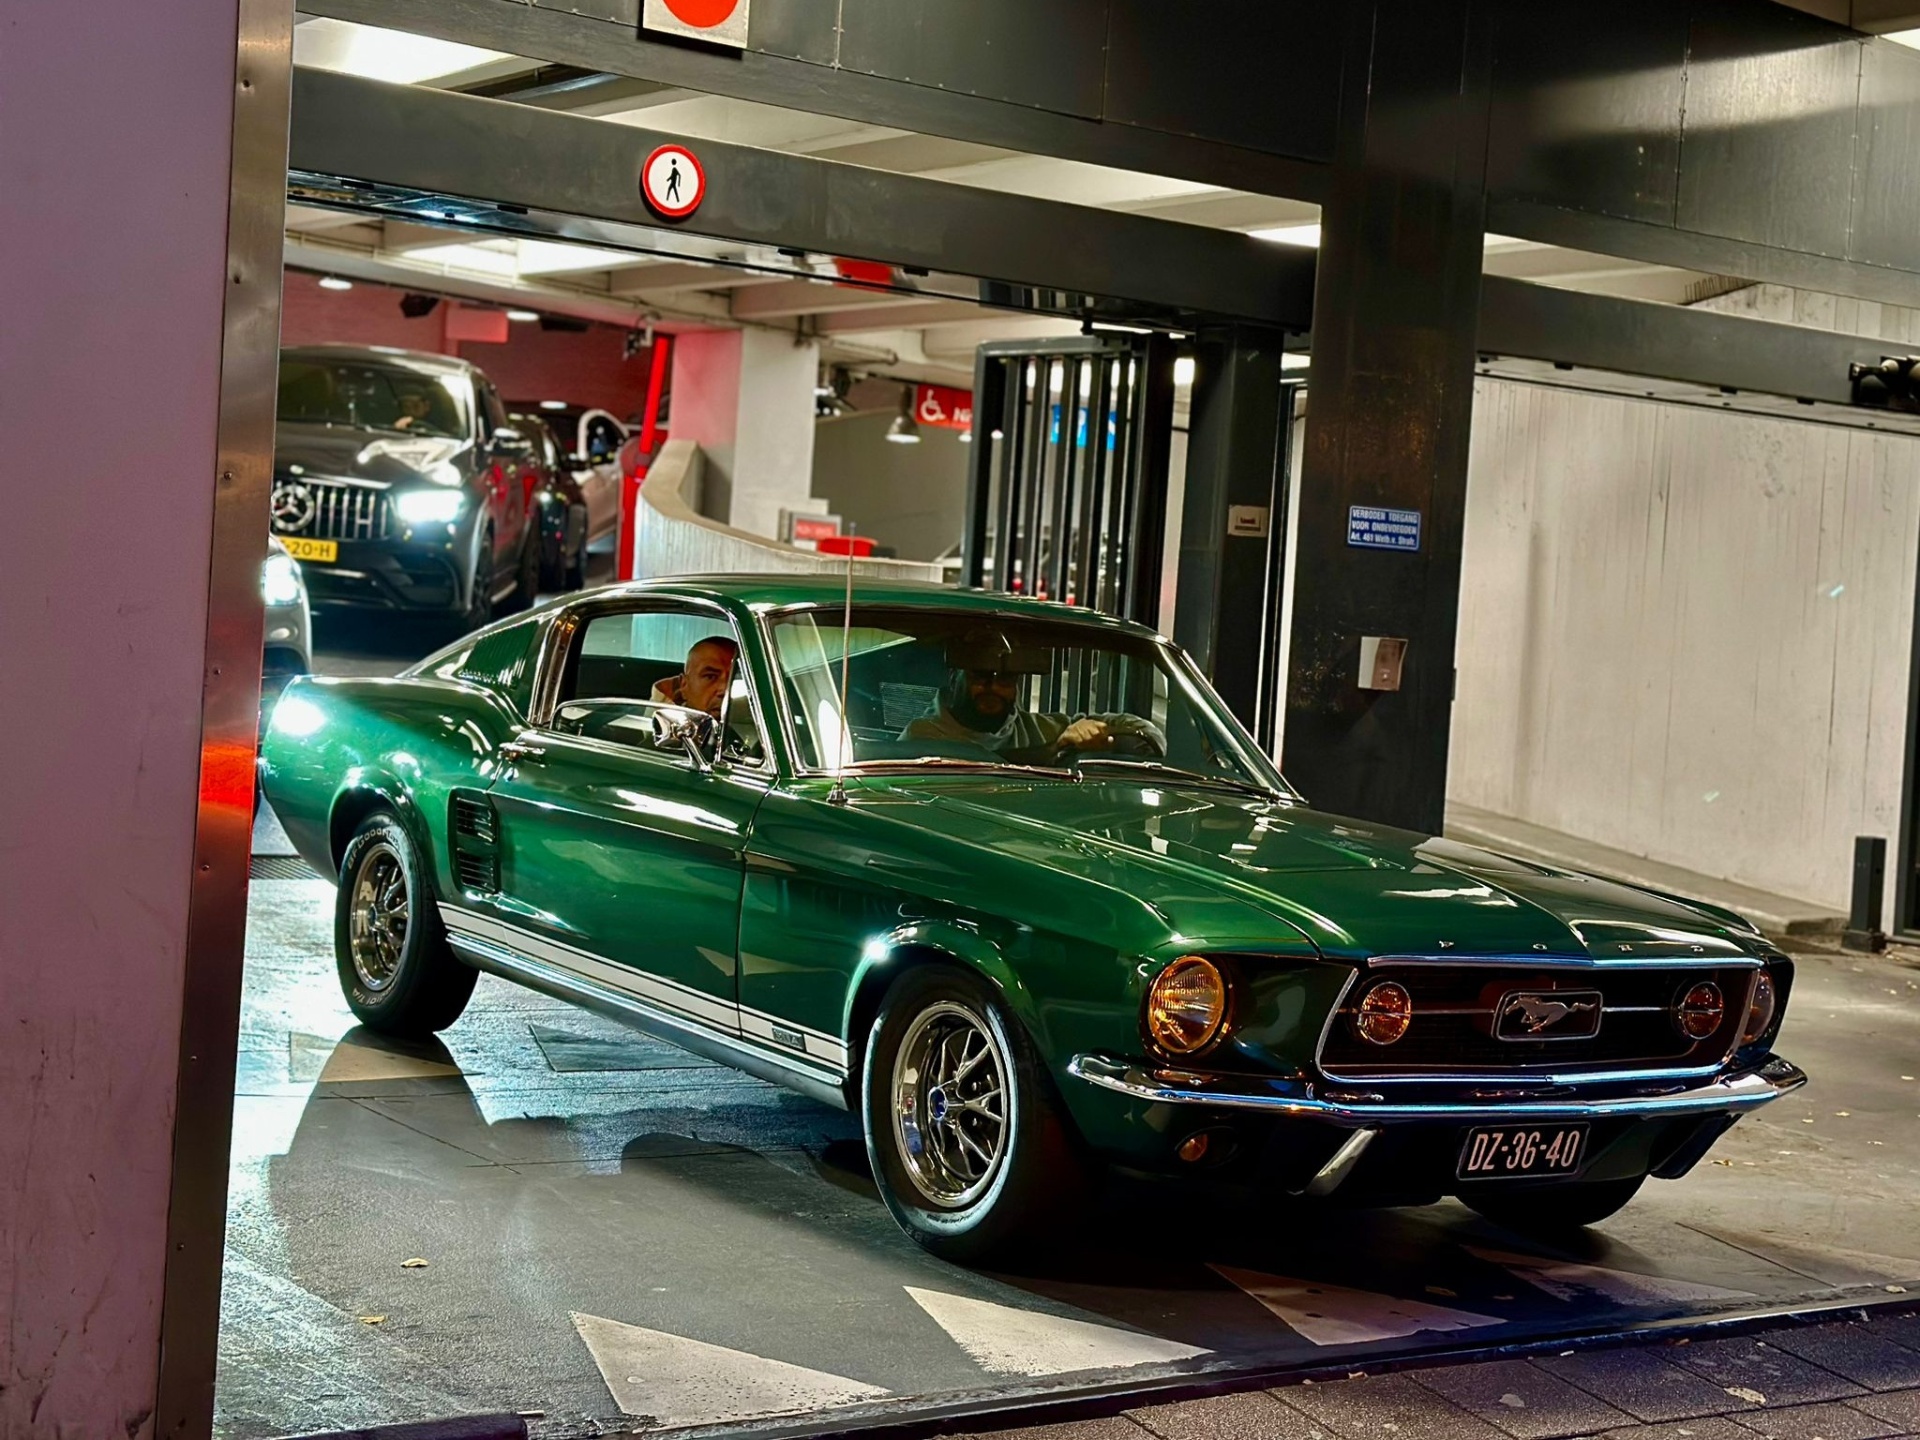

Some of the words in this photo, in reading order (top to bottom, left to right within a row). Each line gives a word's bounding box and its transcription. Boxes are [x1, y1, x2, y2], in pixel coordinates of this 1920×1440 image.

[1352, 509, 1386, 521] VERBODEN
[1388, 512, 1418, 523] TOEGANG
[1351, 520, 1370, 531] VOOR
[1371, 522, 1417, 535] ONBEVOEGDEN
[1467, 1130, 1581, 1171] DZ-36-40
